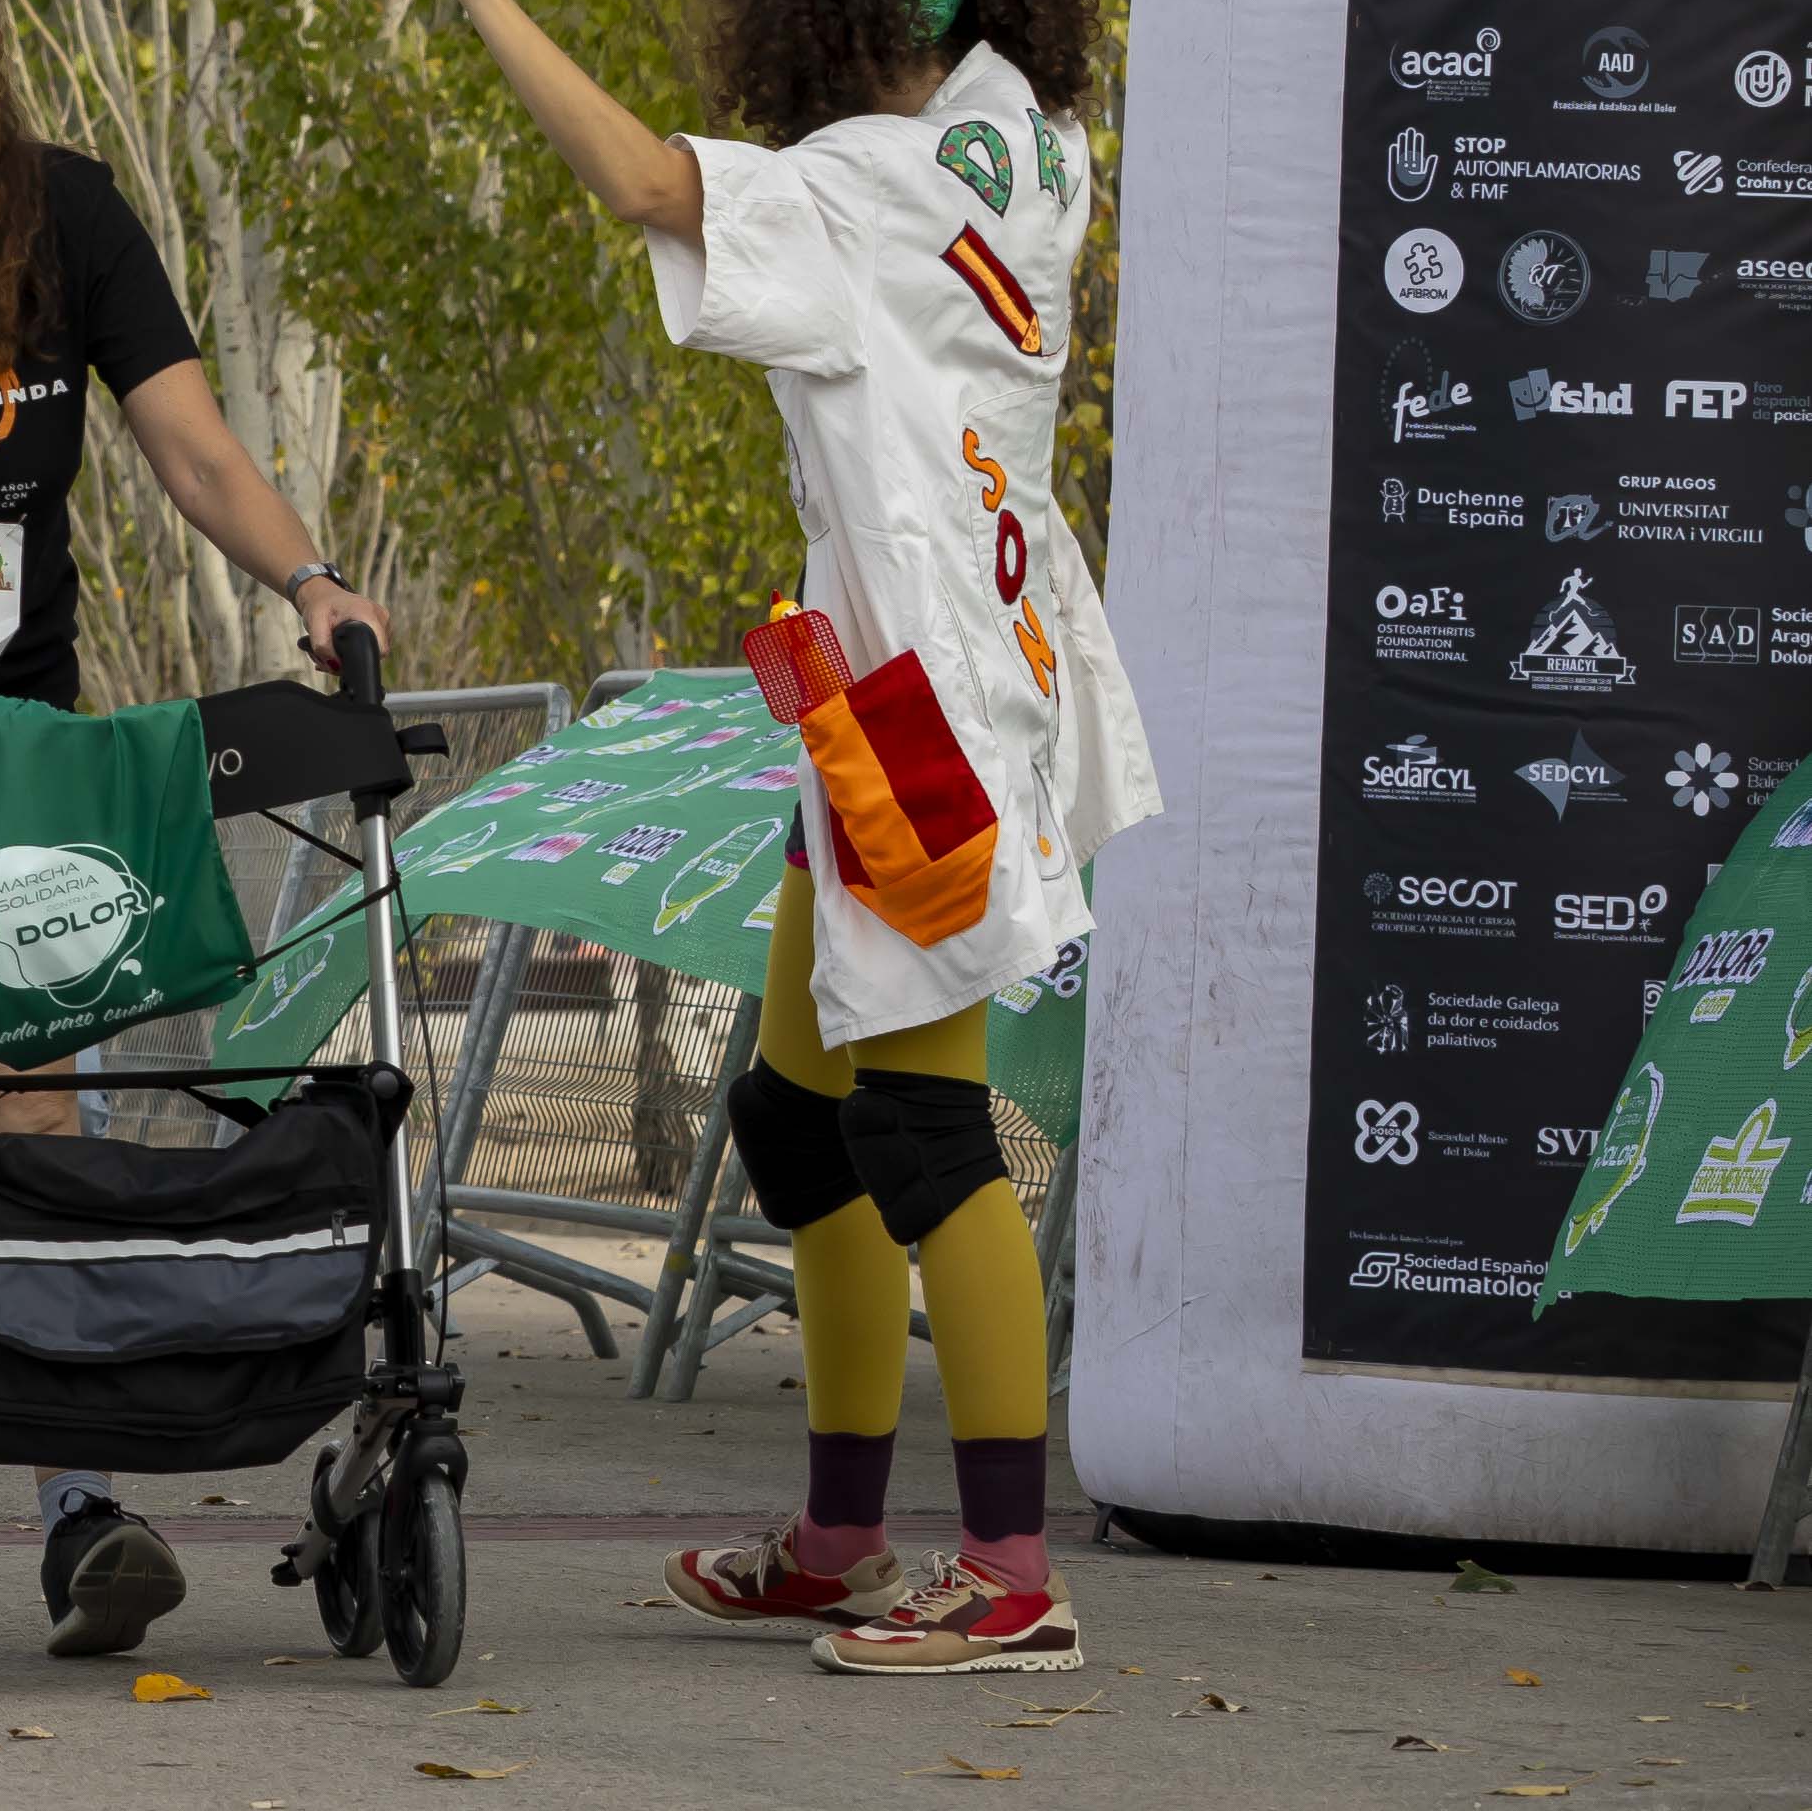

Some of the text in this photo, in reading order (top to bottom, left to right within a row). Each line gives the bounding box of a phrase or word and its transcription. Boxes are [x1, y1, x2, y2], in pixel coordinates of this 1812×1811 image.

[1401, 27, 1501, 77] acaci
[1598, 52, 1635, 73] AAD
[1454, 136, 1506, 154] STOP
[1453, 159, 1641, 182] AUTOINFLAMATORIAS
[1450, 182, 1509, 200] & FMF
[1736, 175, 1782, 189] Crohn
[1784, 179, 1793, 192] y
[1399, 288, 1449, 300] AFIBROM
[1392, 370, 1473, 444] fede
[1549, 380, 1633, 415] fshd
[1665, 379, 1747, 419] FEP
[1619, 475, 1717, 491] GRUP ALGOS
[4, 491, 28, 501] CON
[1417, 487, 1524, 508] Duchenne
[1448, 508, 1524, 529] España
[1619, 502, 1730, 519] UNIVERSITAT
[1618, 525, 1686, 541] ROVIRA
[1699, 528, 1763, 544] VIRGILI
[1377, 623, 1476, 638] OSTEOARTHRITIS
[1771, 628, 1812, 648] Arag
[1377, 636, 1452, 649] FOUNDATION
[1376, 648, 1470, 662] INTERNATIONAL
[1546, 657, 1599, 673] REHACYL
[1527, 763, 1610, 785] SEDCYL
[1747, 774, 1783, 789] Bale
[15, 890, 149, 947] DOLOR
[1554, 893, 1635, 932] SED
[45, 1011, 95, 1039] paso
[103, 987, 167, 1023] cuenta
[1428, 991, 1560, 1016] Sociedade Galega
[1427, 1011, 1560, 1032] da dor e coidados
[1427, 1031, 1497, 1049] paliativos
[1404, 1252, 1478, 1271] Sociedad
[1395, 1268, 1571, 1301] Reumatolo
